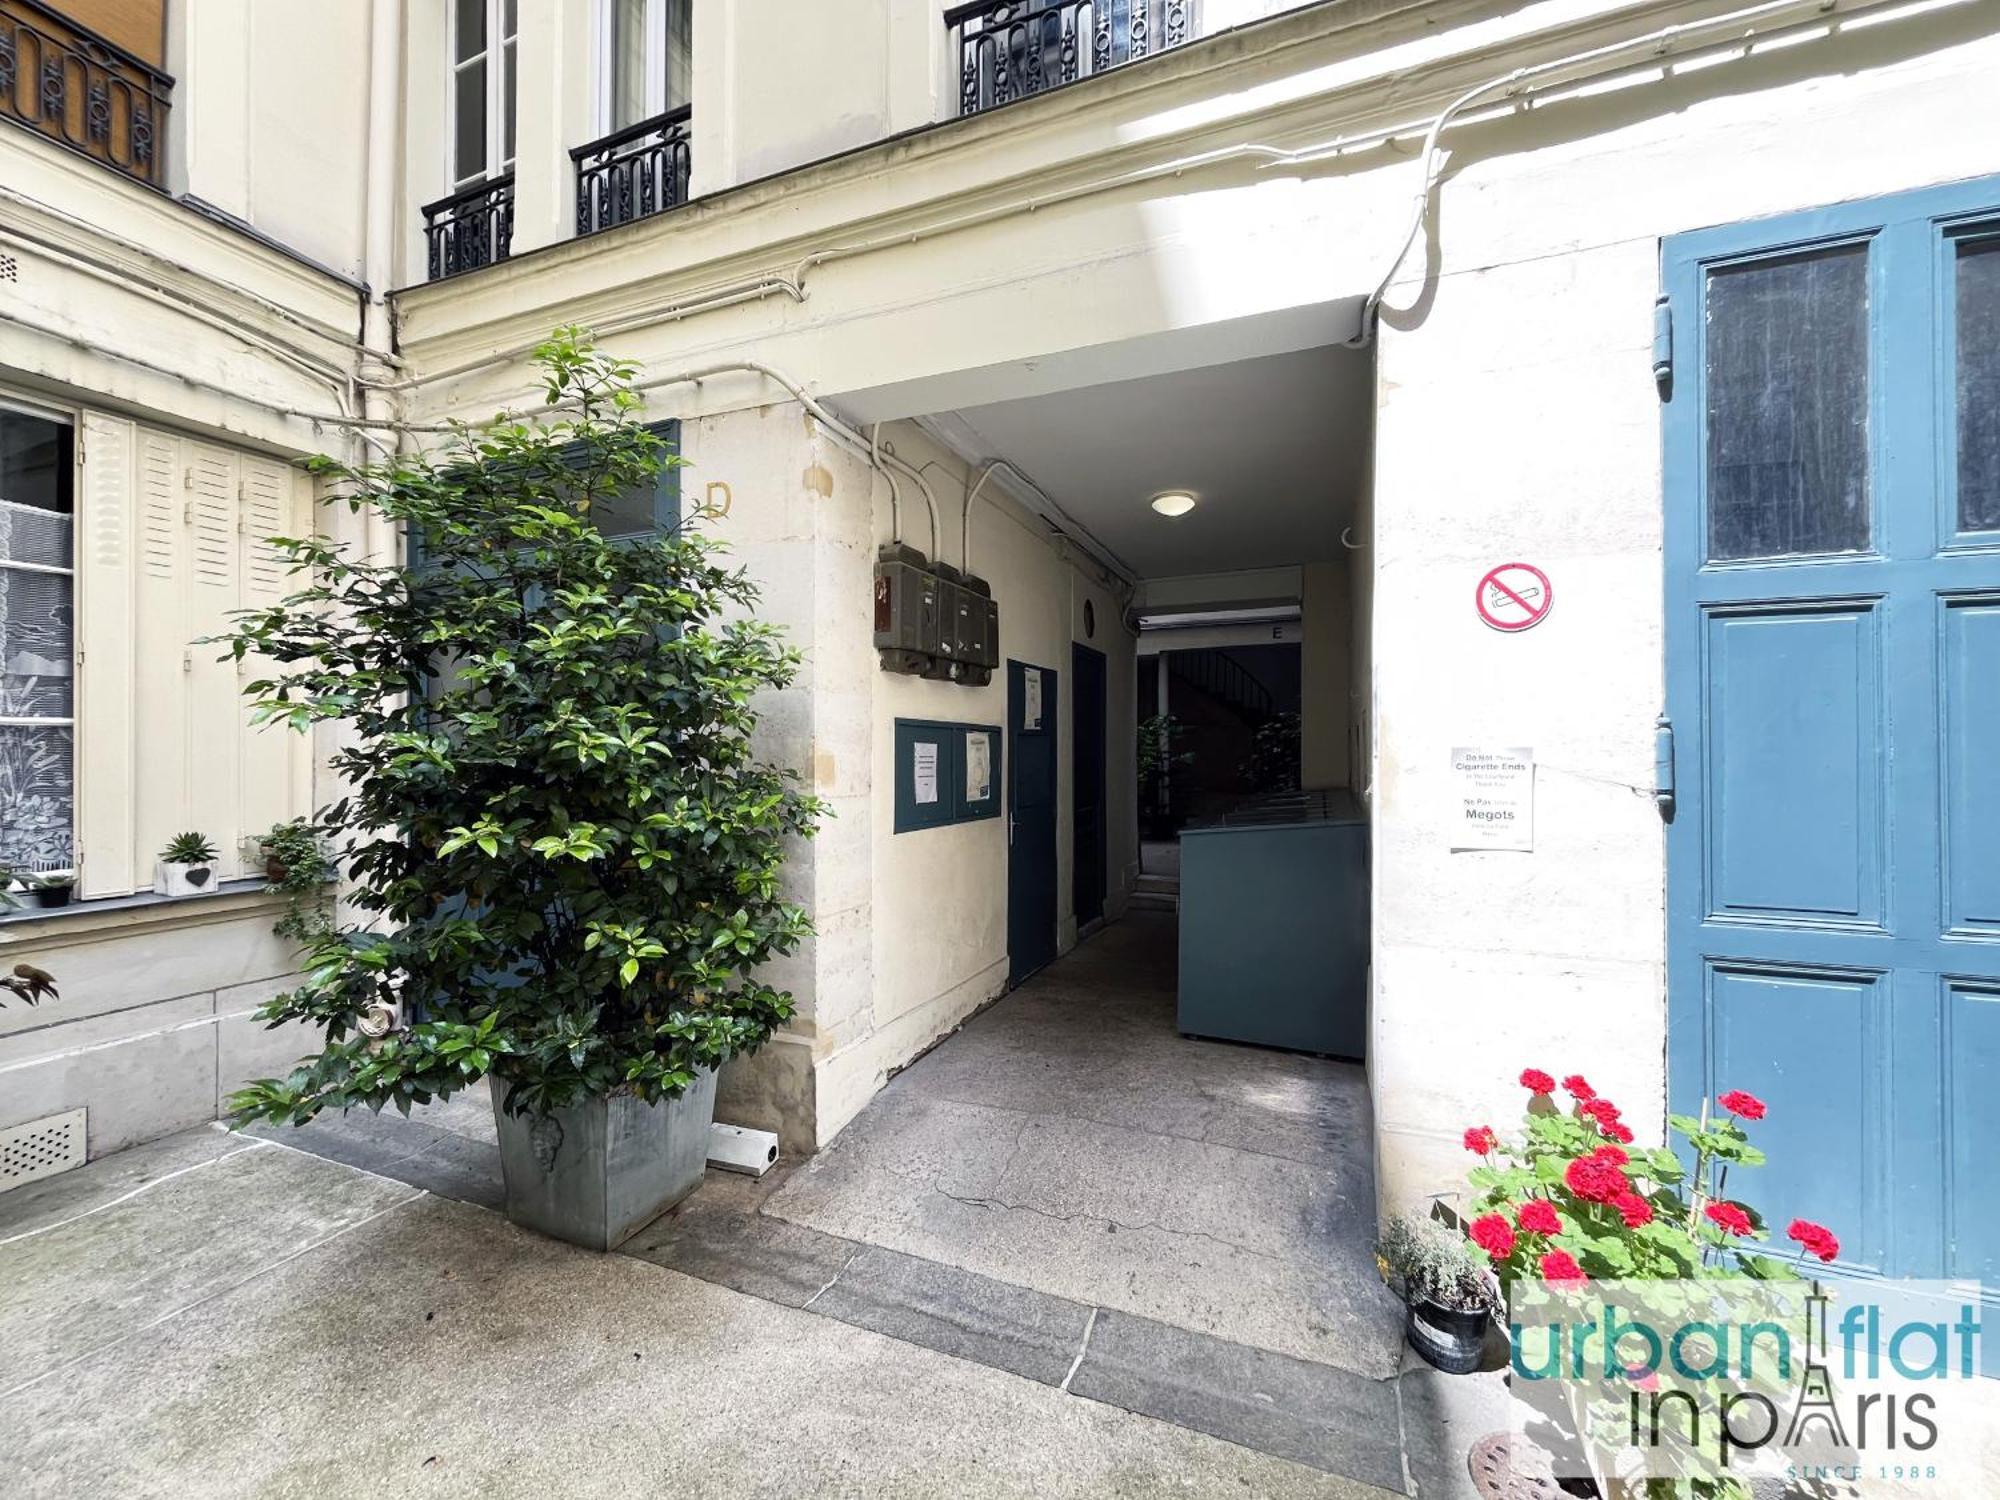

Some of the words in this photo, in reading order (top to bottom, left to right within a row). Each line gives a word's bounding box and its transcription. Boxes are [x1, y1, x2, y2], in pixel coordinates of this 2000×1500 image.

[706, 481, 733, 518] D
[1272, 627, 1283, 639] E
[1455, 762, 1499, 771] Cigarette
[1502, 762, 1526, 771] Ends
[1466, 809, 1515, 822] Megots
